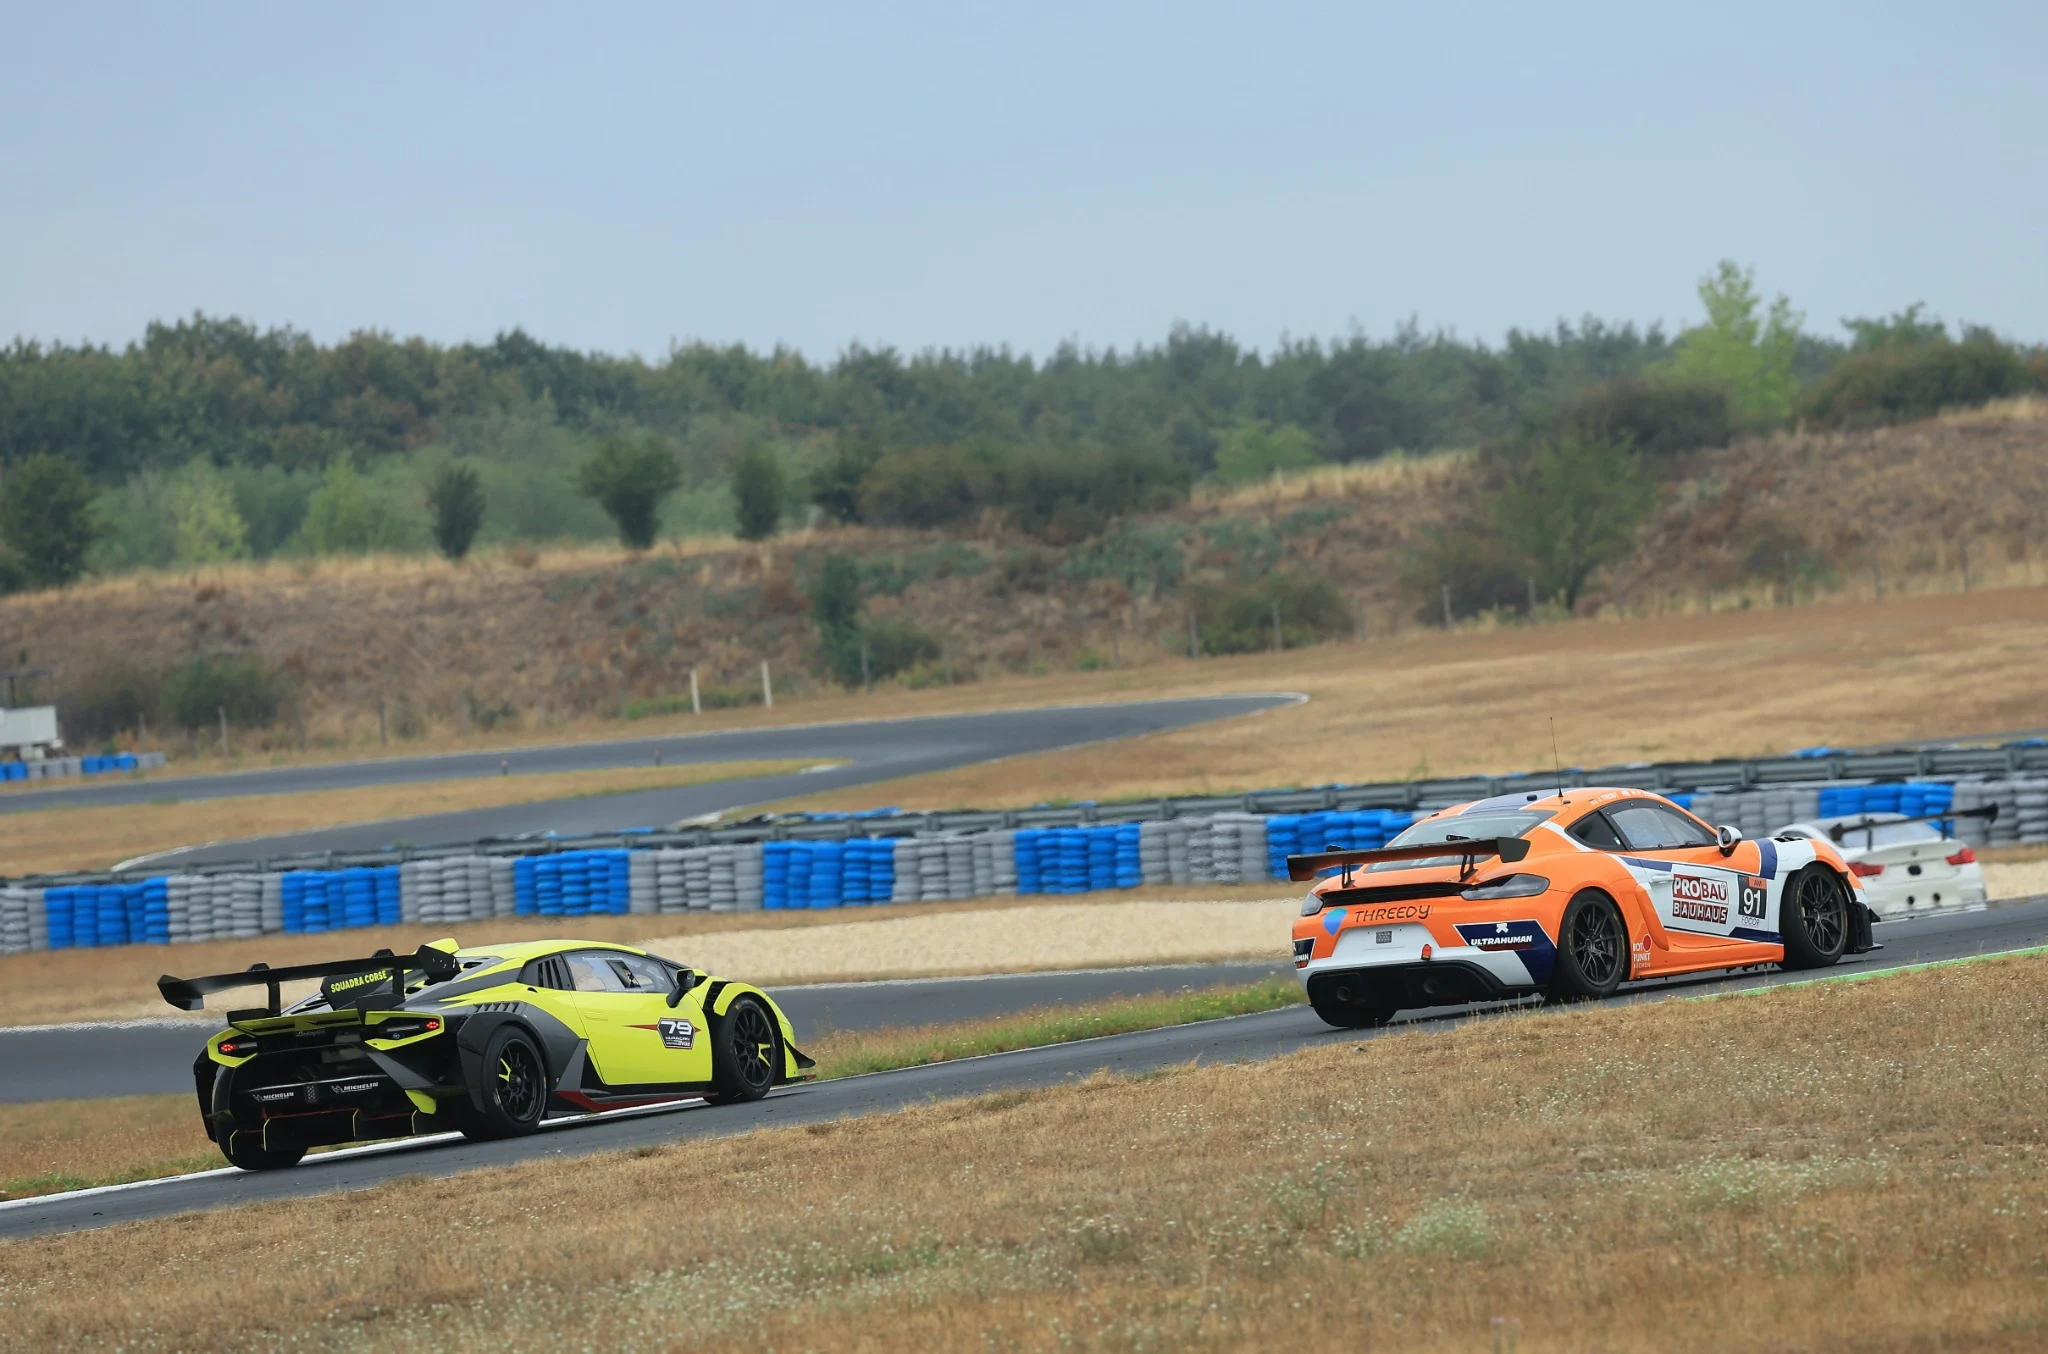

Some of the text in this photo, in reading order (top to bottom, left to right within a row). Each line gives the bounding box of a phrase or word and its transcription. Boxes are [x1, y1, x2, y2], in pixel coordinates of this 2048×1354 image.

[1673, 877, 1727, 901] PROBAU
[1753, 879, 1762, 887] AM
[1743, 887, 1761, 916] 91
[1355, 905, 1431, 923] THREEDY
[1673, 902, 1727, 921] BAUHAUS
[1470, 935, 1533, 946] ULTRAHUMAN
[330, 970, 388, 993] SQUADRA CORSE
[660, 1020, 693, 1035] 79
[343, 1082, 379, 1091] MICHELIN
[263, 1091, 294, 1101] MICHELIN
